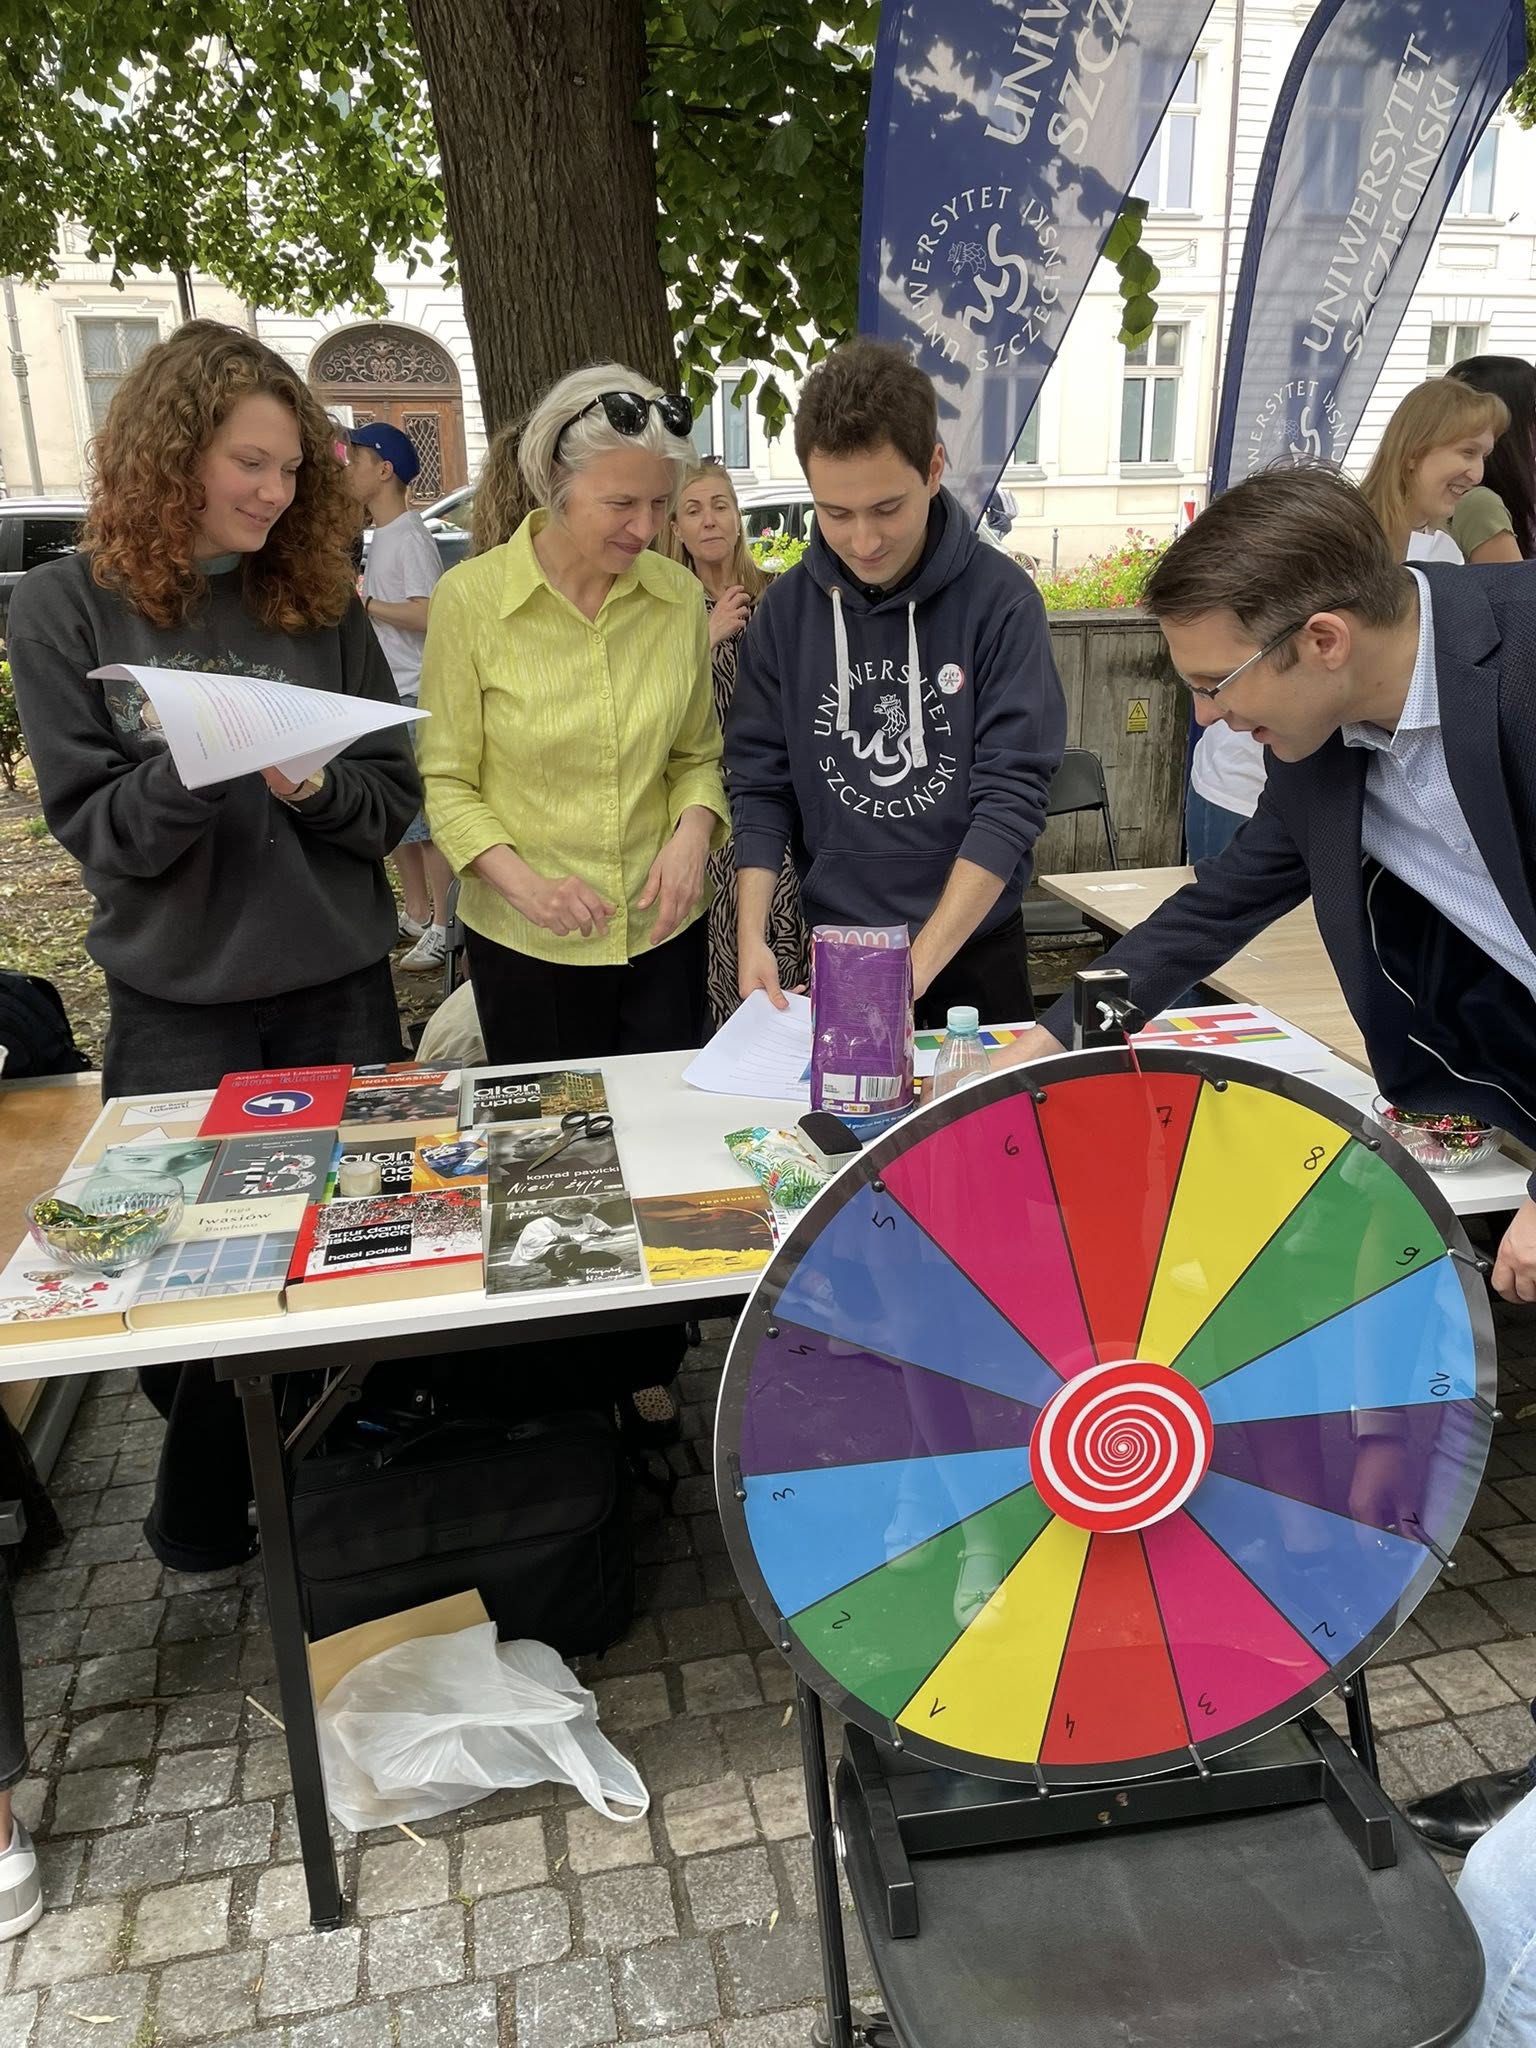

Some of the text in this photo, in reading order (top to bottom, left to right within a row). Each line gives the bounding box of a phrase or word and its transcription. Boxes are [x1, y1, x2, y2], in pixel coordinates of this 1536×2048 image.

[1302, 33, 1432, 352] UNIWERSYTET
[1343, 74, 1460, 361] SZCZECIŃSKI
[909, 186, 1013, 363] UNIWERSYTET
[975, 198, 1063, 371] SZCZECIŃSKI
[819, 753, 957, 819] SZCZECIŃSKI
[473, 1082, 541, 1098] alan
[1156, 1105, 1173, 1126] 7
[340, 1150, 415, 1164] alan
[1302, 1146, 1326, 1171] 8
[526, 1166, 620, 1181] konrad pawicki
[507, 1180, 554, 1196] Niech
[199, 1211, 272, 1225] Iwasiów
[327, 1229, 364, 1239] artur
[328, 1245, 408, 1262] hotel polski
[1428, 1372, 1450, 1396] 10
[772, 1487, 796, 1503] 3
[830, 1611, 852, 1630] 2
[1312, 1621, 1337, 1640] 2
[928, 1697, 947, 1718] 1
[1196, 1693, 1216, 1716] 3
[1064, 1714, 1077, 1739] 4
